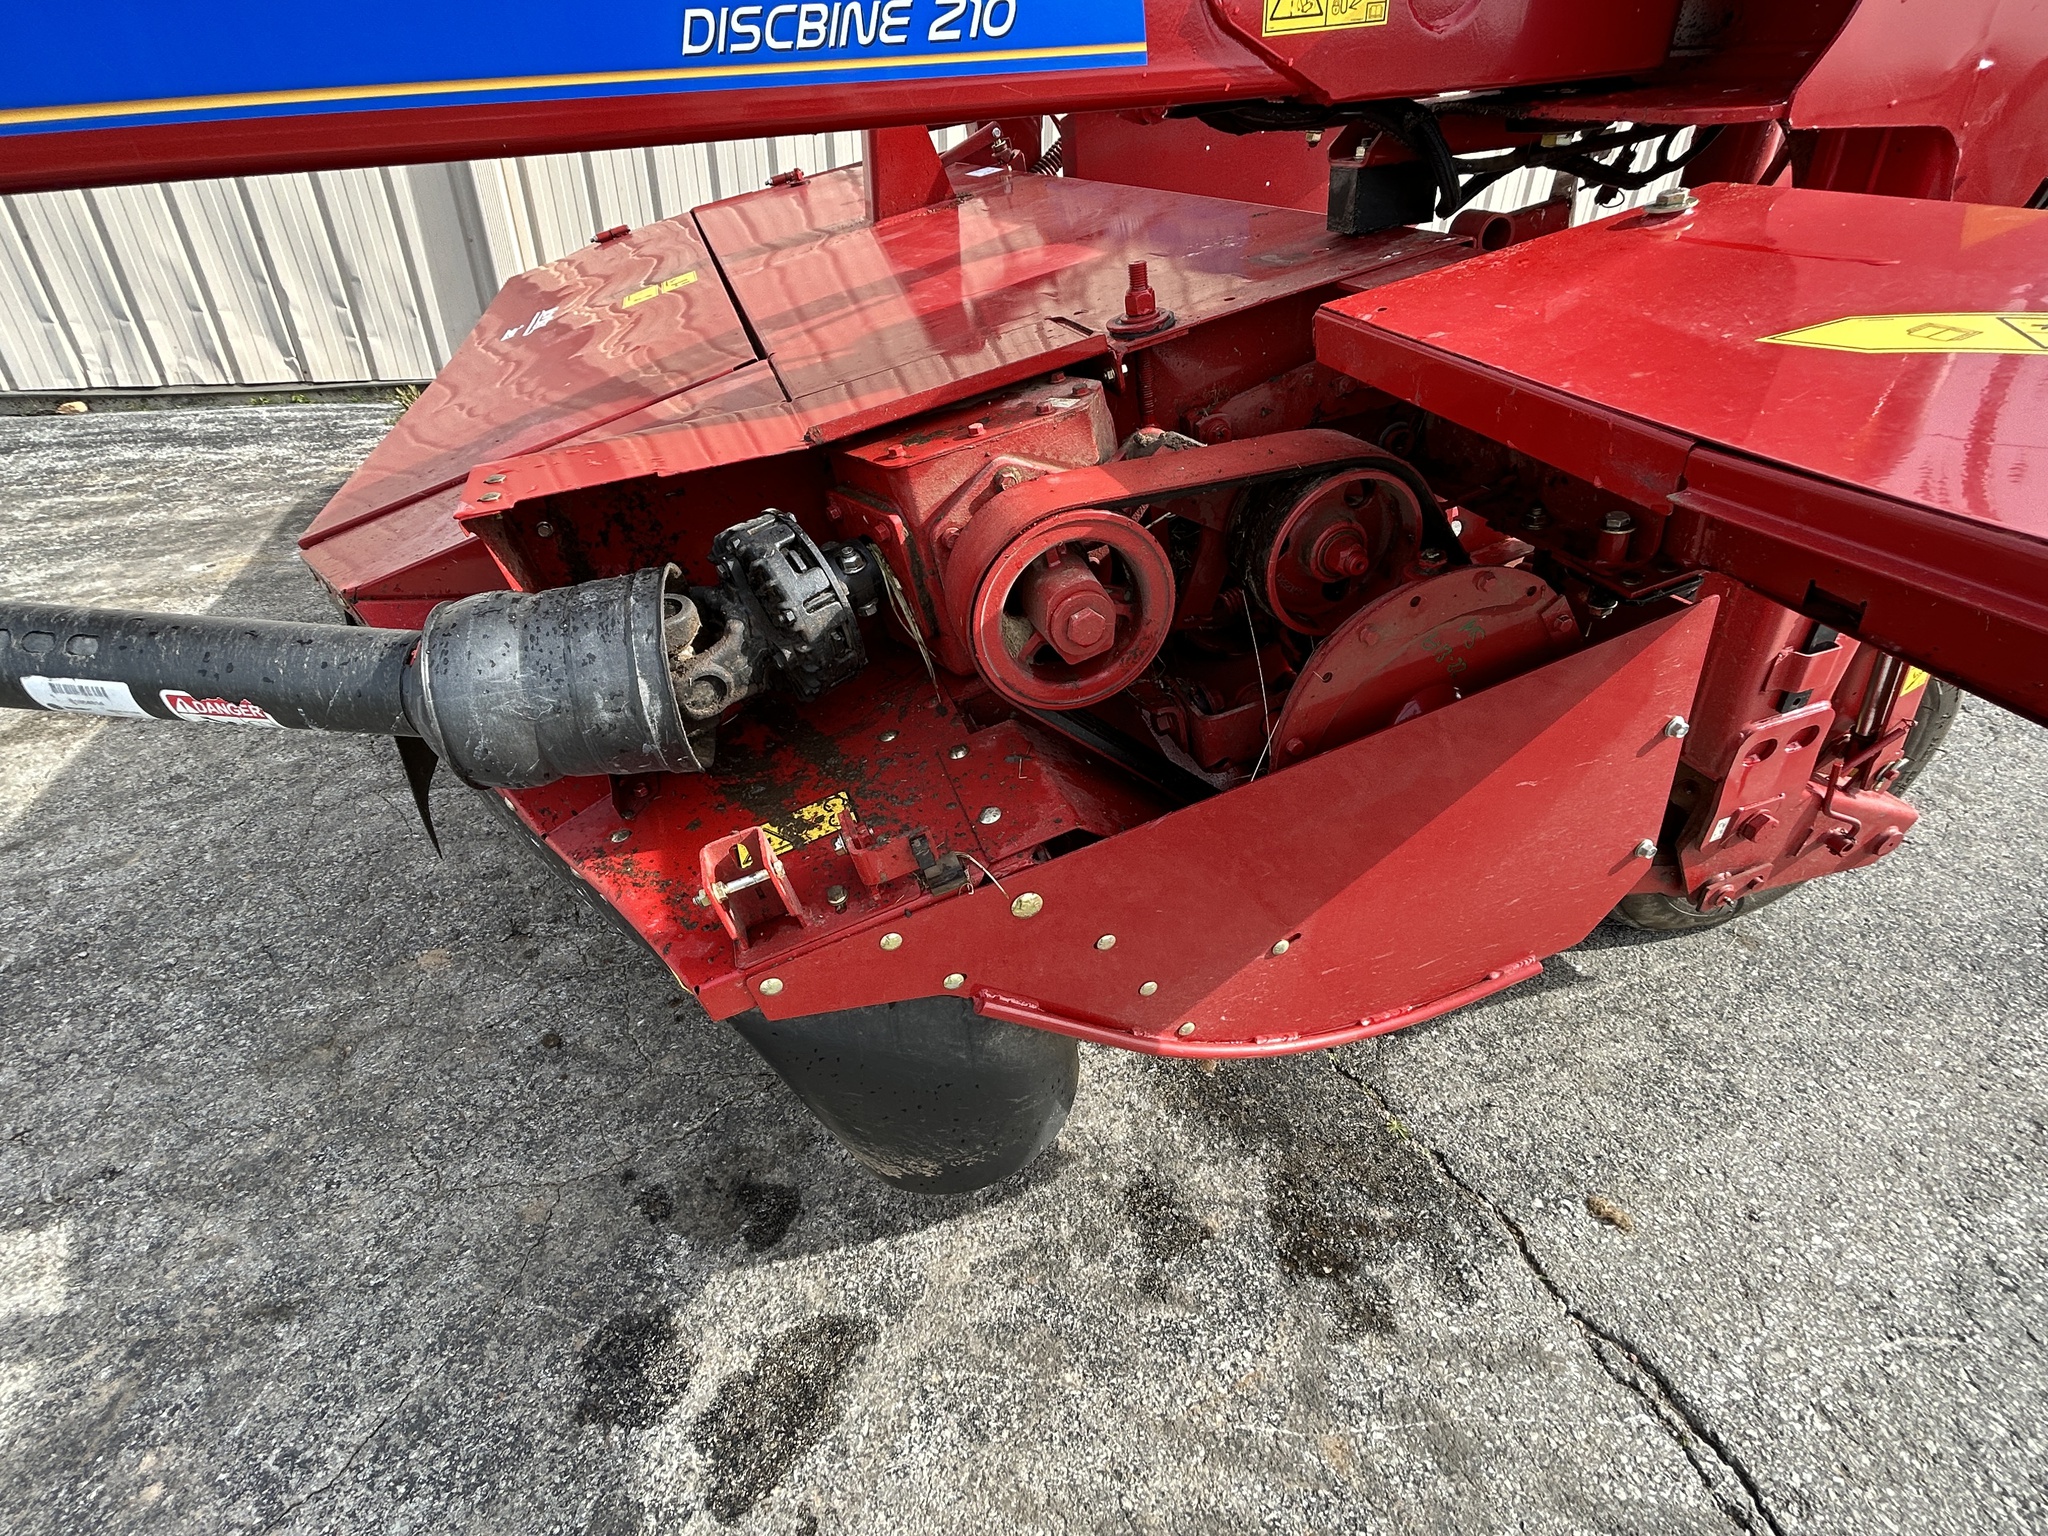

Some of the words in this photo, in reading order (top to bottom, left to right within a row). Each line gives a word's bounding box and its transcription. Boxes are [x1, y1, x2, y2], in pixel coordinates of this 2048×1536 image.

[682, 0, 914, 56] DISCBINE
[927, 0, 1018, 43] 210
[192, 700, 267, 718] DANGER
